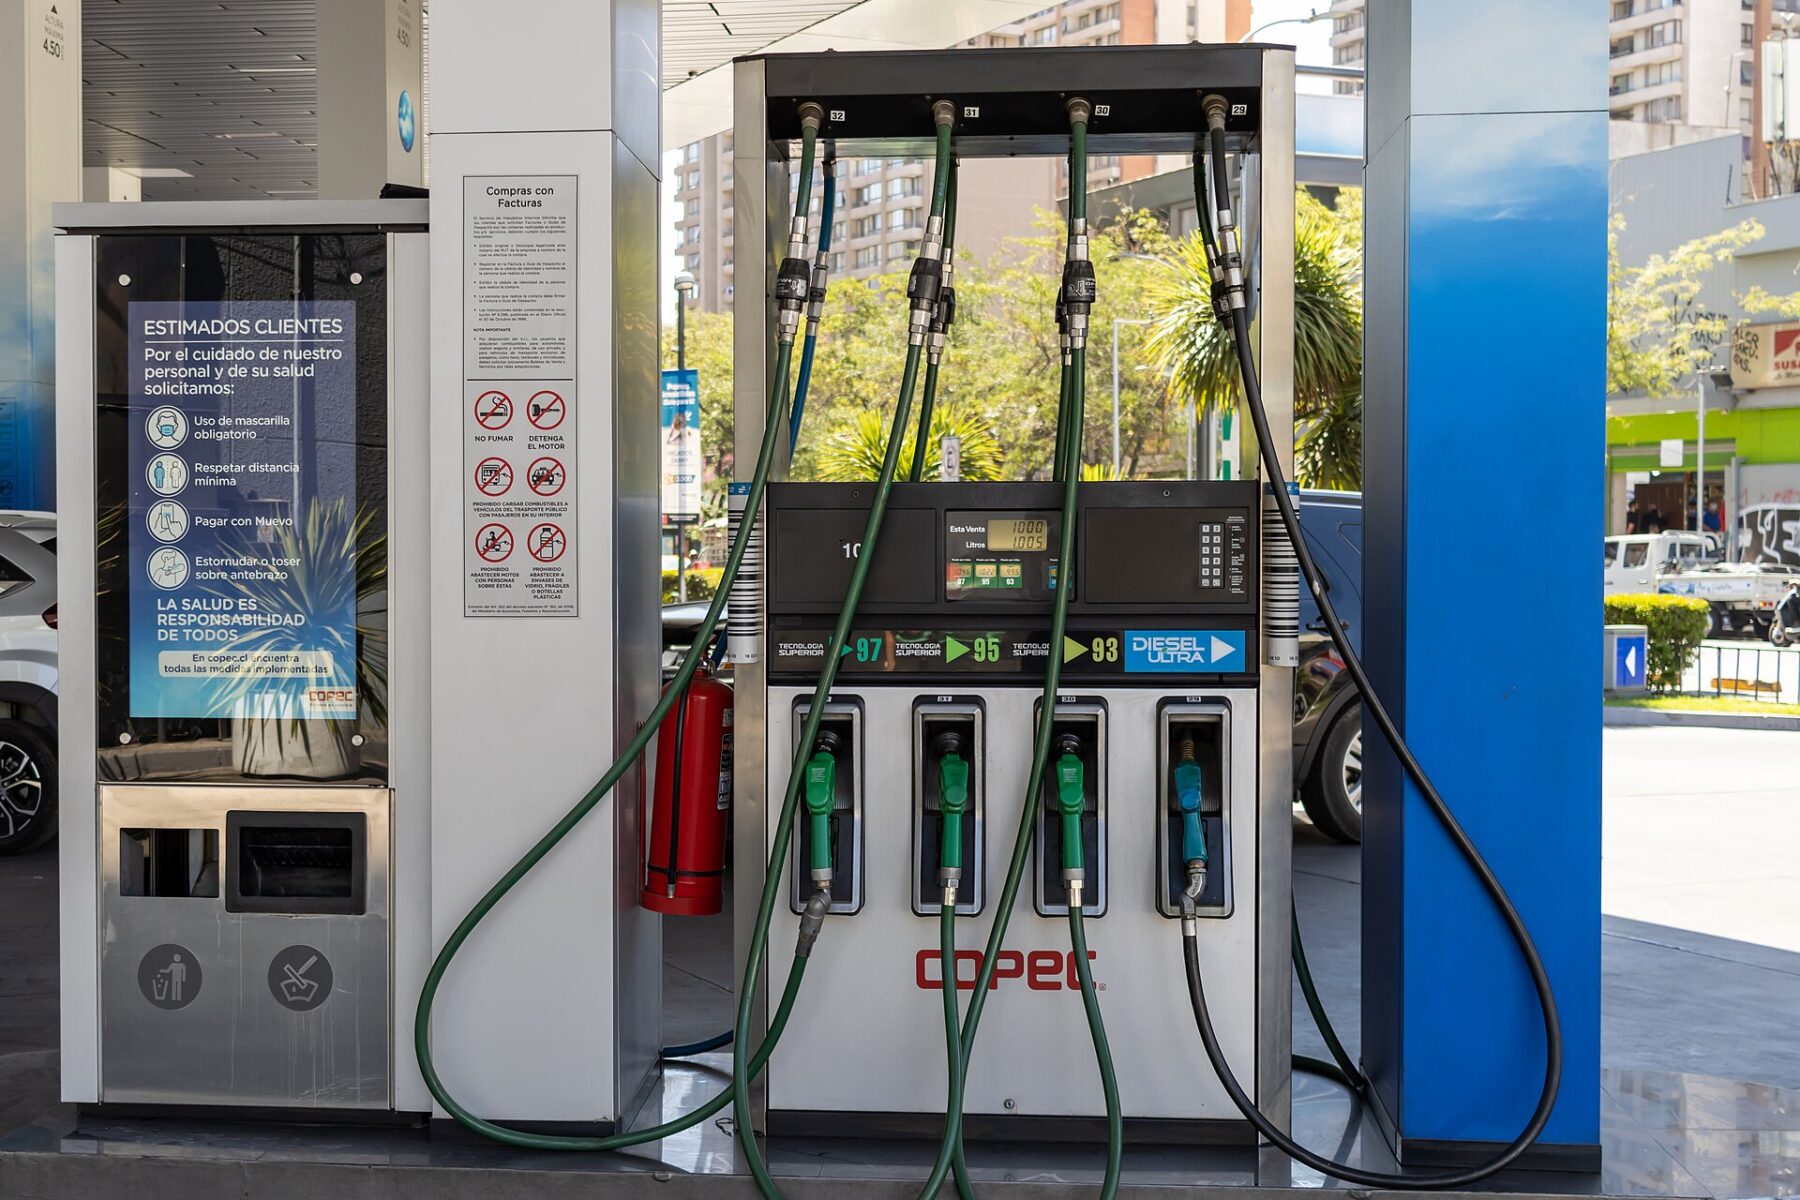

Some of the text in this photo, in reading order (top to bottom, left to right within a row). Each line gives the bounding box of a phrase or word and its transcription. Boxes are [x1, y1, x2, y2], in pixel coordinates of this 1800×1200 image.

[831, 112, 843, 120] 32
[486, 187, 532, 196] Compras
[498, 199, 542, 207] Facturas
[144, 319, 343, 336] ESTIMADOS CLIENTES
[145, 347, 342, 361] Por el cuidado de nuestro
[145, 364, 315, 380] personal y de su salud
[144, 382, 234, 395] solicitamos:
[194, 416, 290, 426] Uso de mascarilla
[194, 430, 257, 441] obligatorio
[195, 463, 300, 475] Respetar distancia
[195, 476, 237, 486] mínima
[195, 517, 228, 527] Pagar
[255, 517, 293, 526] Muevo
[1013, 521, 1044, 533] 1000
[195, 557, 258, 566] Estornudar
[272, 558, 300, 566] toser
[195, 570, 288, 580] sobre antebrazo
[157, 599, 257, 610] LA SALUD ES
[157, 614, 305, 626] RESPONSABILIDAD
[157, 629, 238, 641] DE TODOS
[1092, 637, 1118, 662] 93
[1132, 637, 1205, 650] DIESEL
[856, 638, 882, 662] 97
[974, 638, 999, 662] 95
[192, 654, 205, 662] En
[207, 654, 248, 664] copec.cl
[1148, 651, 1204, 663] ULTRA
[164, 665, 328, 674] todas las medidas implementadas
